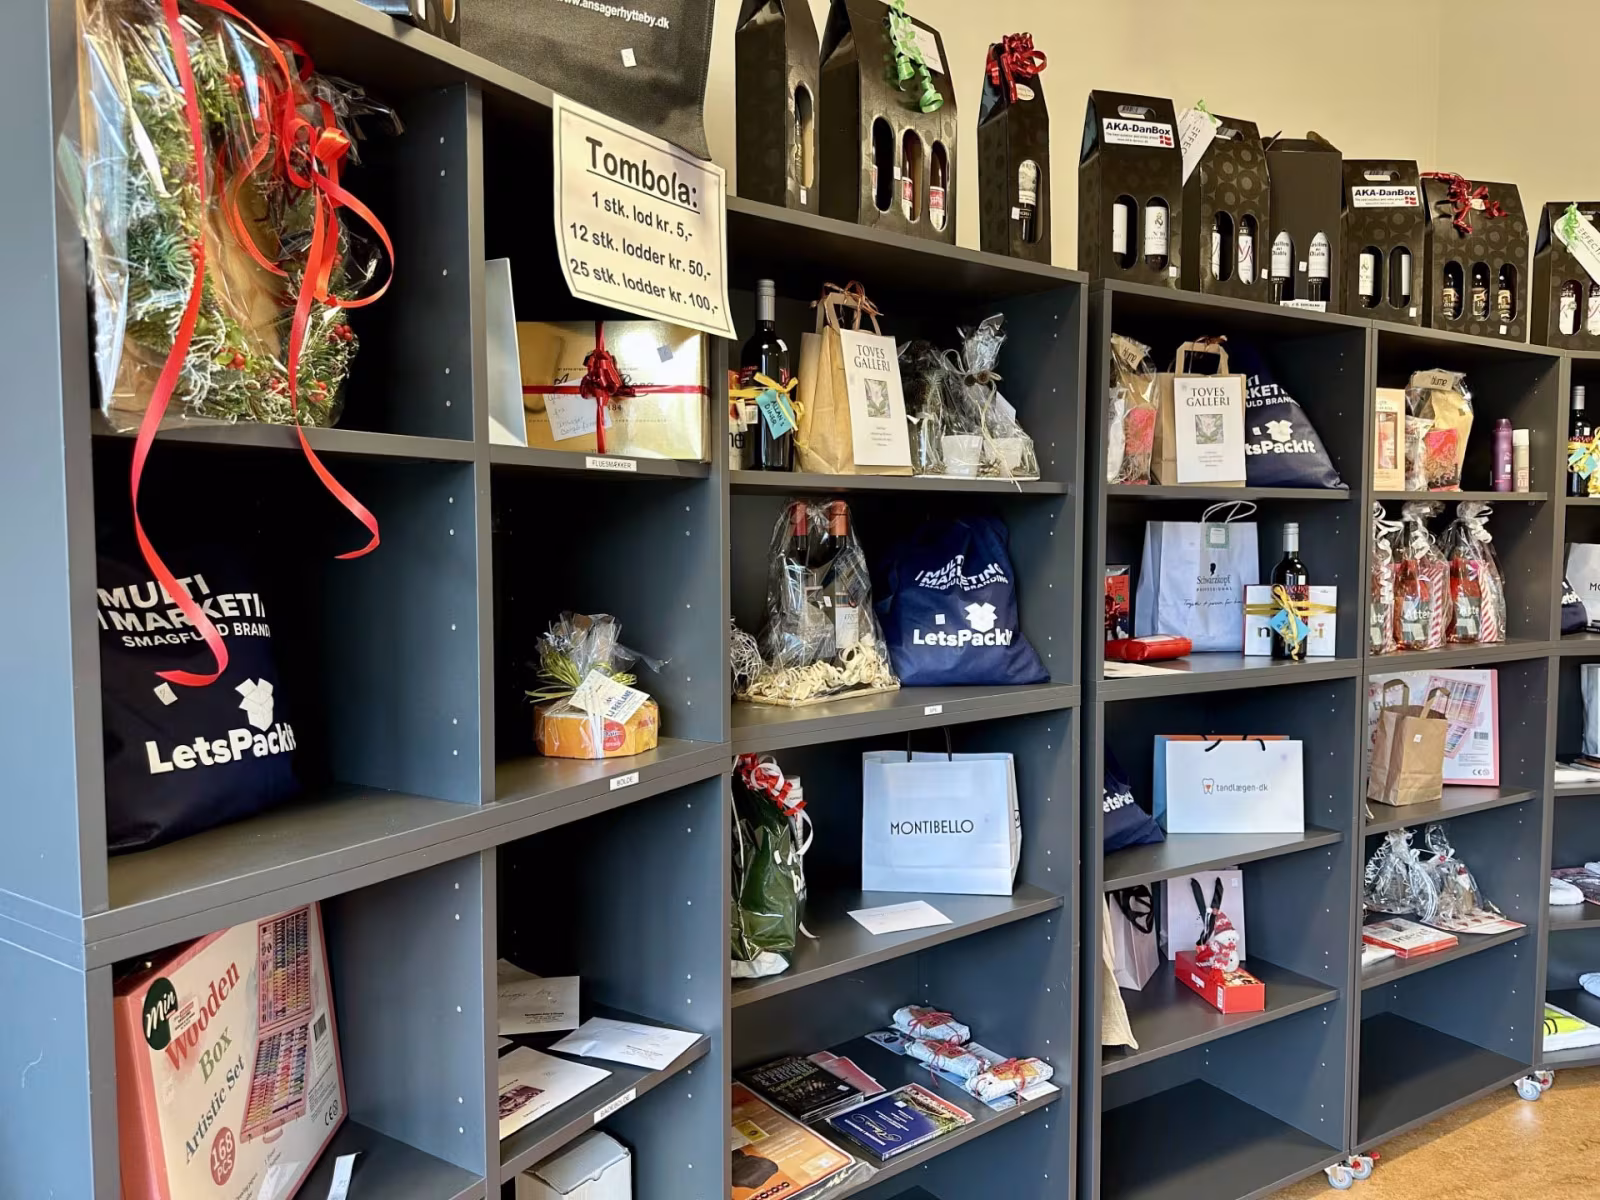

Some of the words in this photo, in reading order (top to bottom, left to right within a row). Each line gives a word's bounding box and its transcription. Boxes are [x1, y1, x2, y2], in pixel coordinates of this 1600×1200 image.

[1105, 121, 1171, 135] AKA-DanBox
[585, 135, 698, 208] Tombola:
[1354, 188, 1416, 197] AKA-DanBox
[592, 191, 599, 208] 1
[604, 197, 629, 219] stk.
[633, 205, 652, 227] lod
[656, 214, 673, 234] kr.
[676, 222, 693, 242] 5,-
[569, 222, 589, 243] 12
[592, 231, 619, 252] stk.
[622, 238, 666, 266] lodder
[668, 253, 686, 272] kr.
[688, 260, 711, 281] 50,-
[570, 258, 590, 278] 25
[592, 266, 621, 286] stk.
[622, 273, 666, 299] lodder
[669, 286, 687, 305] kr.
[688, 292, 719, 315] 100,-
[854, 355, 891, 372] GALLERI
[856, 344, 885, 359] TOVES
[1186, 396, 1230, 407] GALLERI
[1191, 387, 1225, 397] TOVES
[890, 819, 974, 835] MONTIBELLO
[165, 961, 241, 1072] Wooden
[198, 1025, 233, 1084] Box
[185, 1087, 228, 1165] Artistic
[226, 1053, 245, 1092] Set
[211, 1131, 234, 1171] 168
[217, 1157, 233, 1183] PCS
